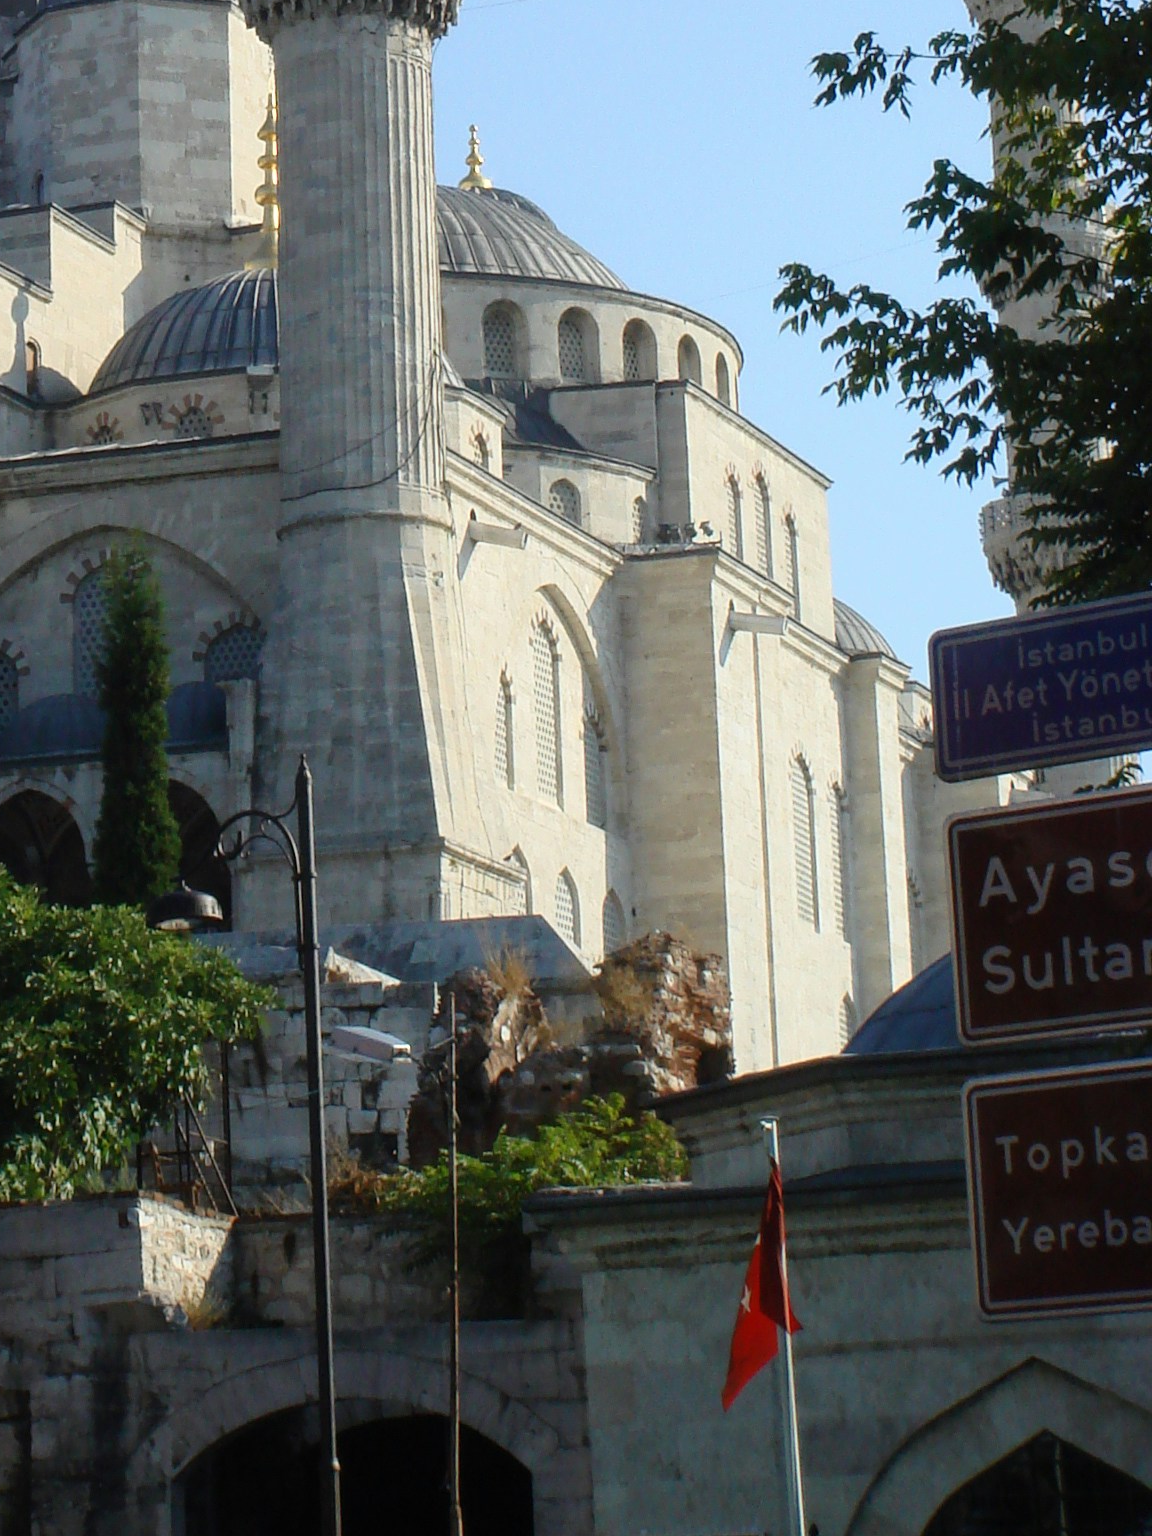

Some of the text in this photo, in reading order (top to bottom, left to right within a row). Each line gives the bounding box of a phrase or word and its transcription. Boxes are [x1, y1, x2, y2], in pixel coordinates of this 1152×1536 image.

[1017, 622, 1147, 669] İstanbul
[980, 677, 1048, 716] Afet
[977, 848, 1152, 915] Ayas
[994, 1124, 1148, 1180] Topka
[1001, 1208, 1152, 1255] Yereba
